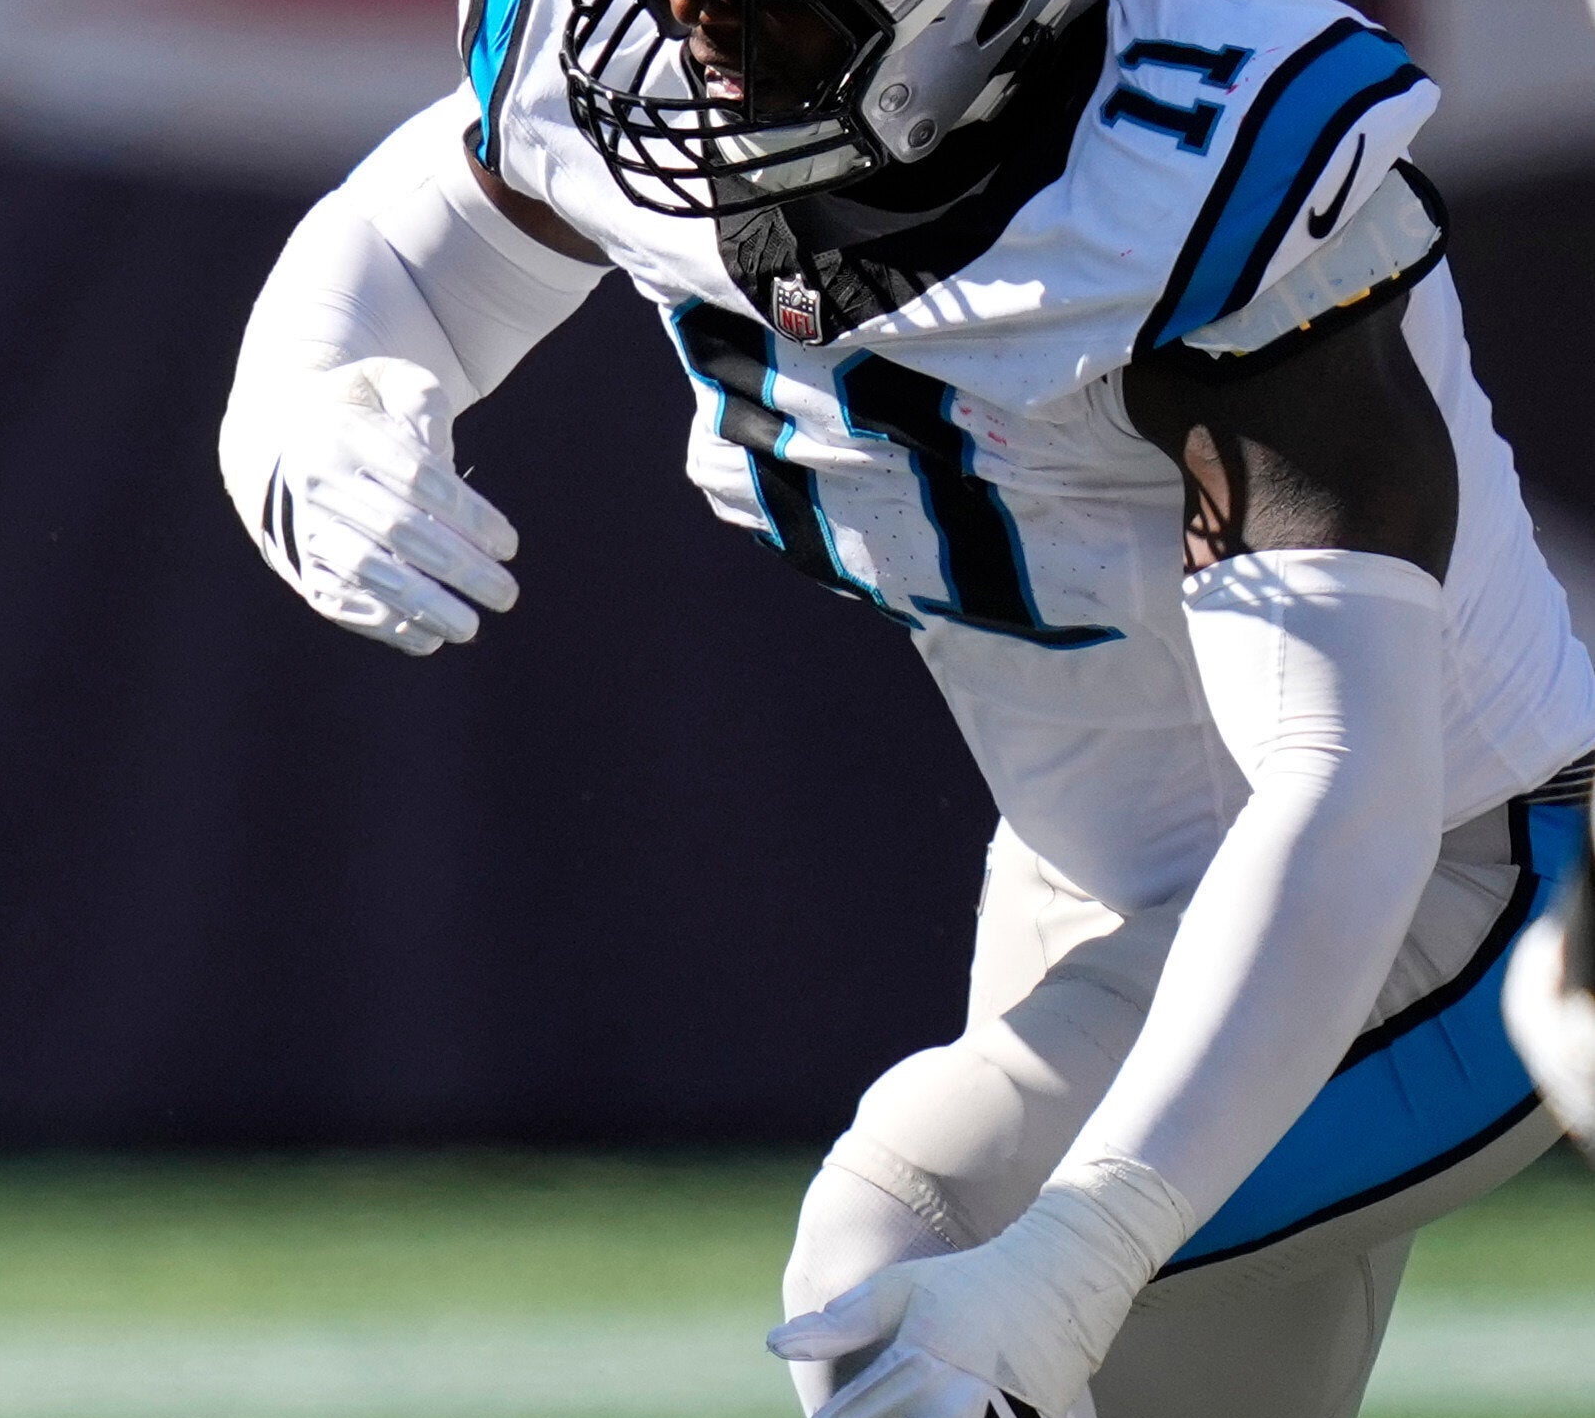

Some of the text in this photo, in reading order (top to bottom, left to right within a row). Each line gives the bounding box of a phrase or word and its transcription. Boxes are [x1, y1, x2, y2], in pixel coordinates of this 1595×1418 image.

[1099, 38, 1256, 157] 11
[781, 309, 818, 339] NFL
[669, 295, 1127, 651] 11
